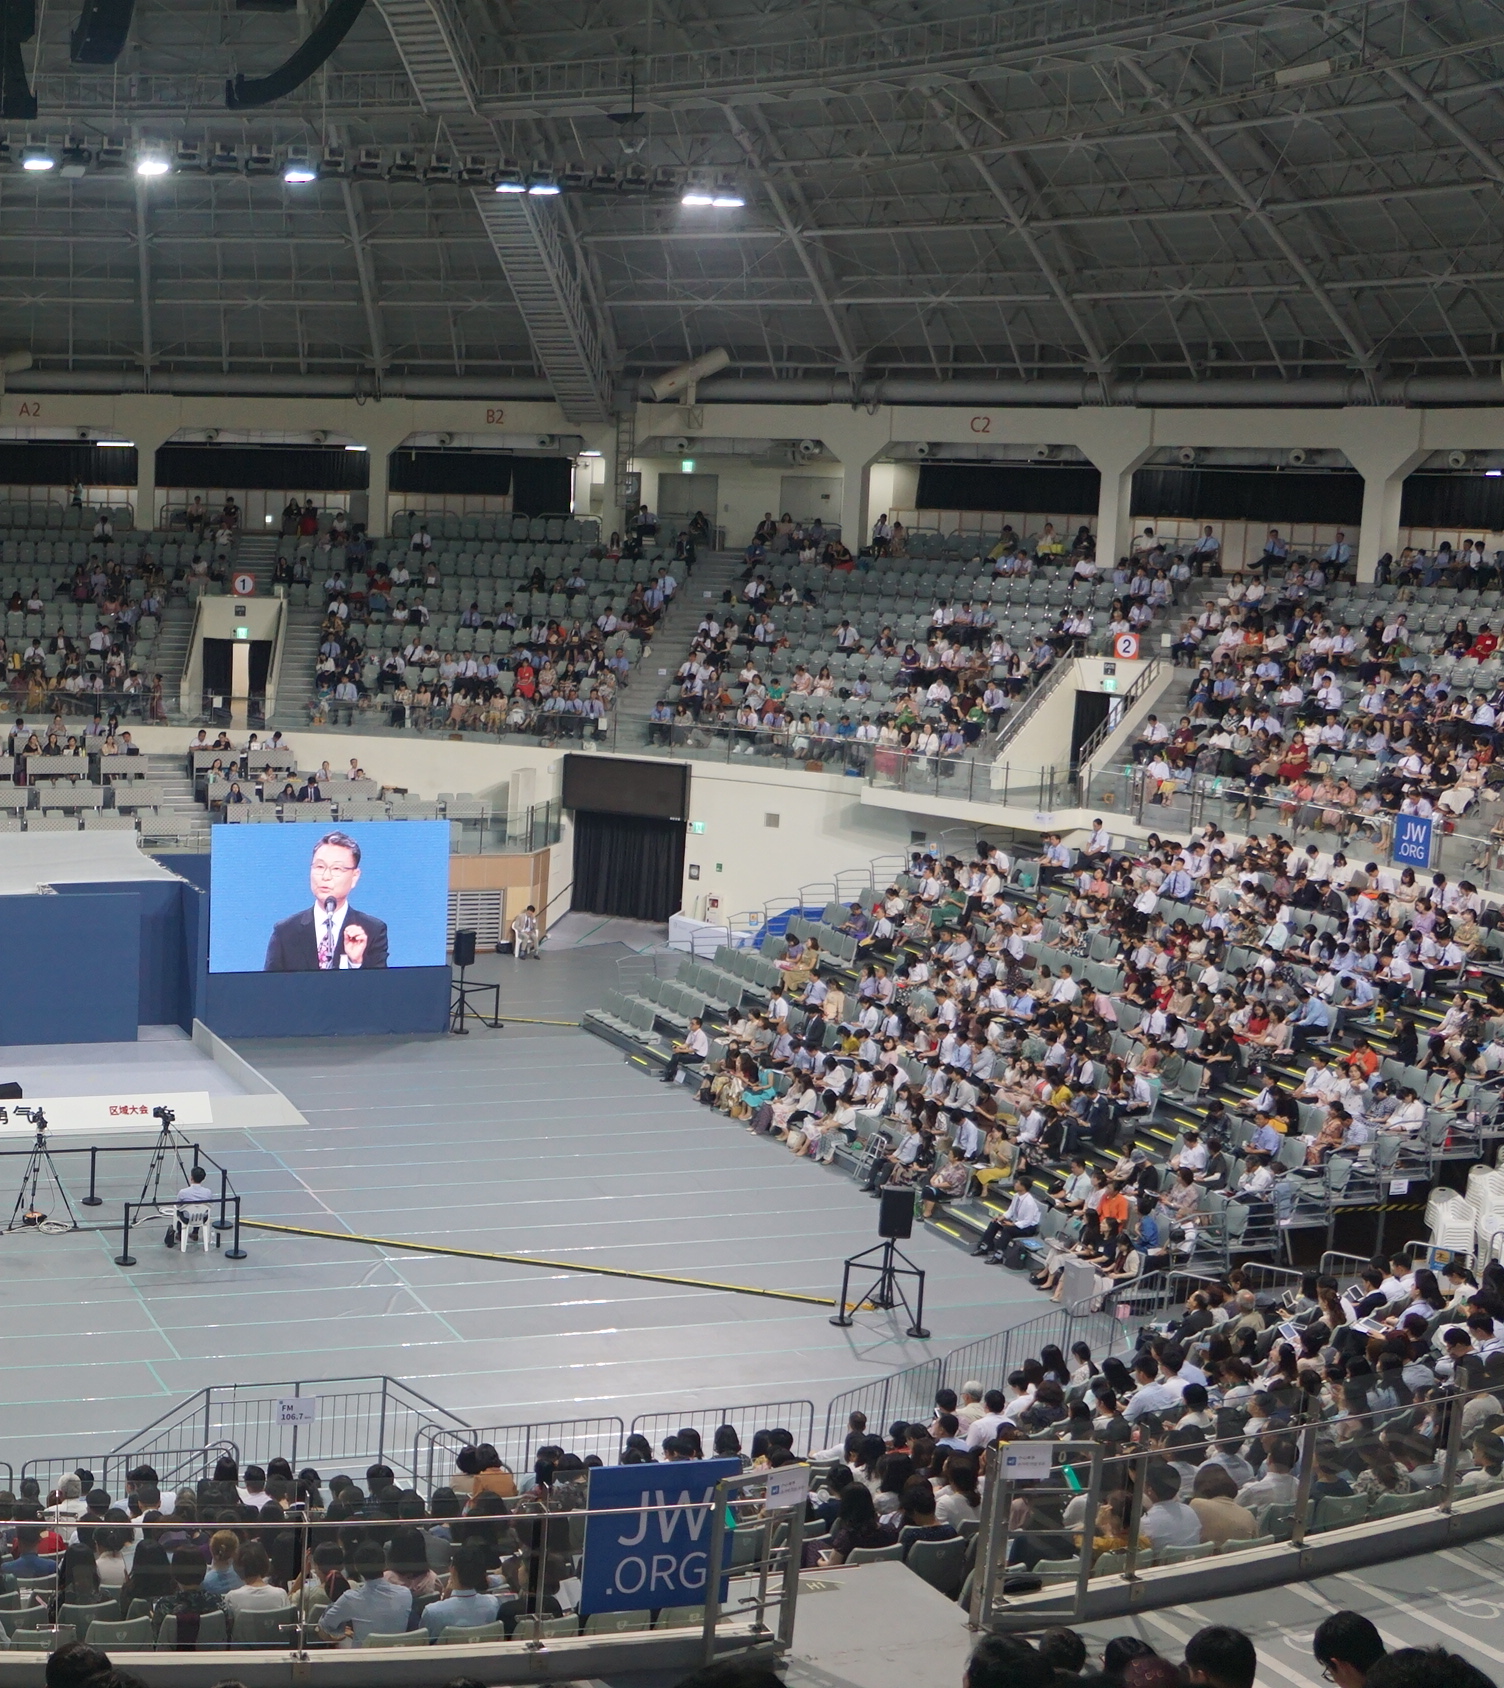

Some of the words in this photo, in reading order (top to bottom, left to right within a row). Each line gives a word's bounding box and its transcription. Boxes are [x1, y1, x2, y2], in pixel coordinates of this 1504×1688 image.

[19, 402, 41, 417] A2
[486, 409, 505, 425] B2
[970, 416, 991, 433] C2
[239, 578, 246, 591] 1
[1122, 638, 1132, 654] 2
[1401, 822, 1427, 844] JW
[1398, 842, 1425, 860] .ORG
[109, 1104, 149, 1116] 区域大会
[281, 1404, 294, 1412] FM
[281, 1412, 304, 1421] 106.7
[617, 1486, 714, 1546] JW
[606, 1551, 708, 1594] .ORG
[806, 1581, 826, 1590] H1
